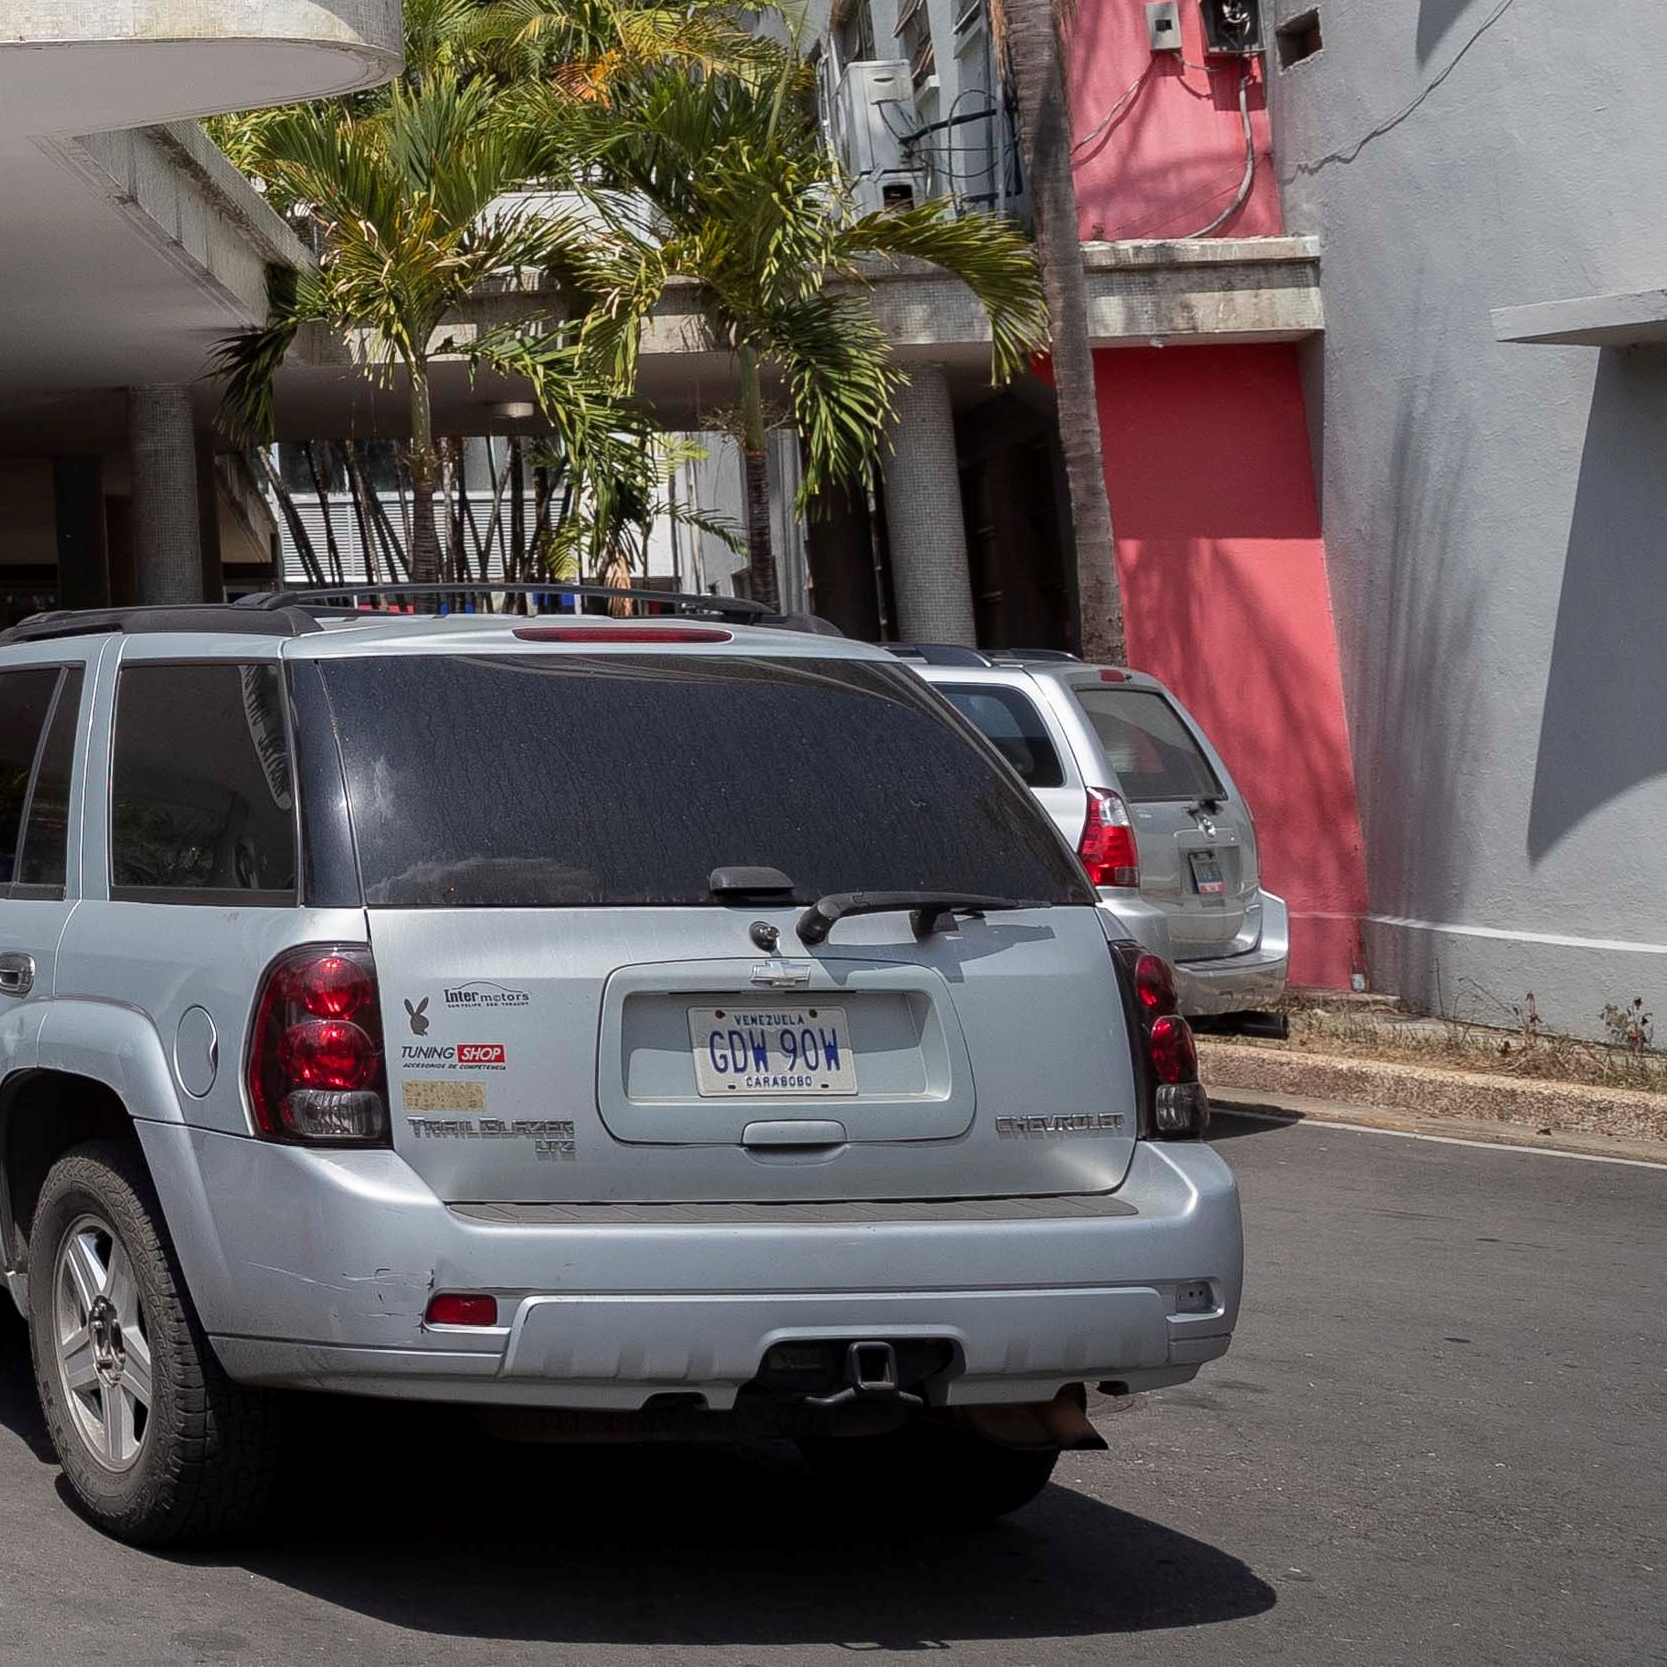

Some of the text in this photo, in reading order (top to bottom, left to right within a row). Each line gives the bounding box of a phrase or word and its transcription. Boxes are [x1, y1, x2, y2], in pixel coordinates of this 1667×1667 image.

[734, 1013, 805, 1026] VENEZUELA
[402, 1045, 502, 1061] TUNING SHOP
[709, 1027, 841, 1073] GDW 90W
[746, 1076, 813, 1088] CARABOBO
[995, 1112, 1124, 1134] CHEVROLET
[535, 1139, 576, 1153] LTZ
